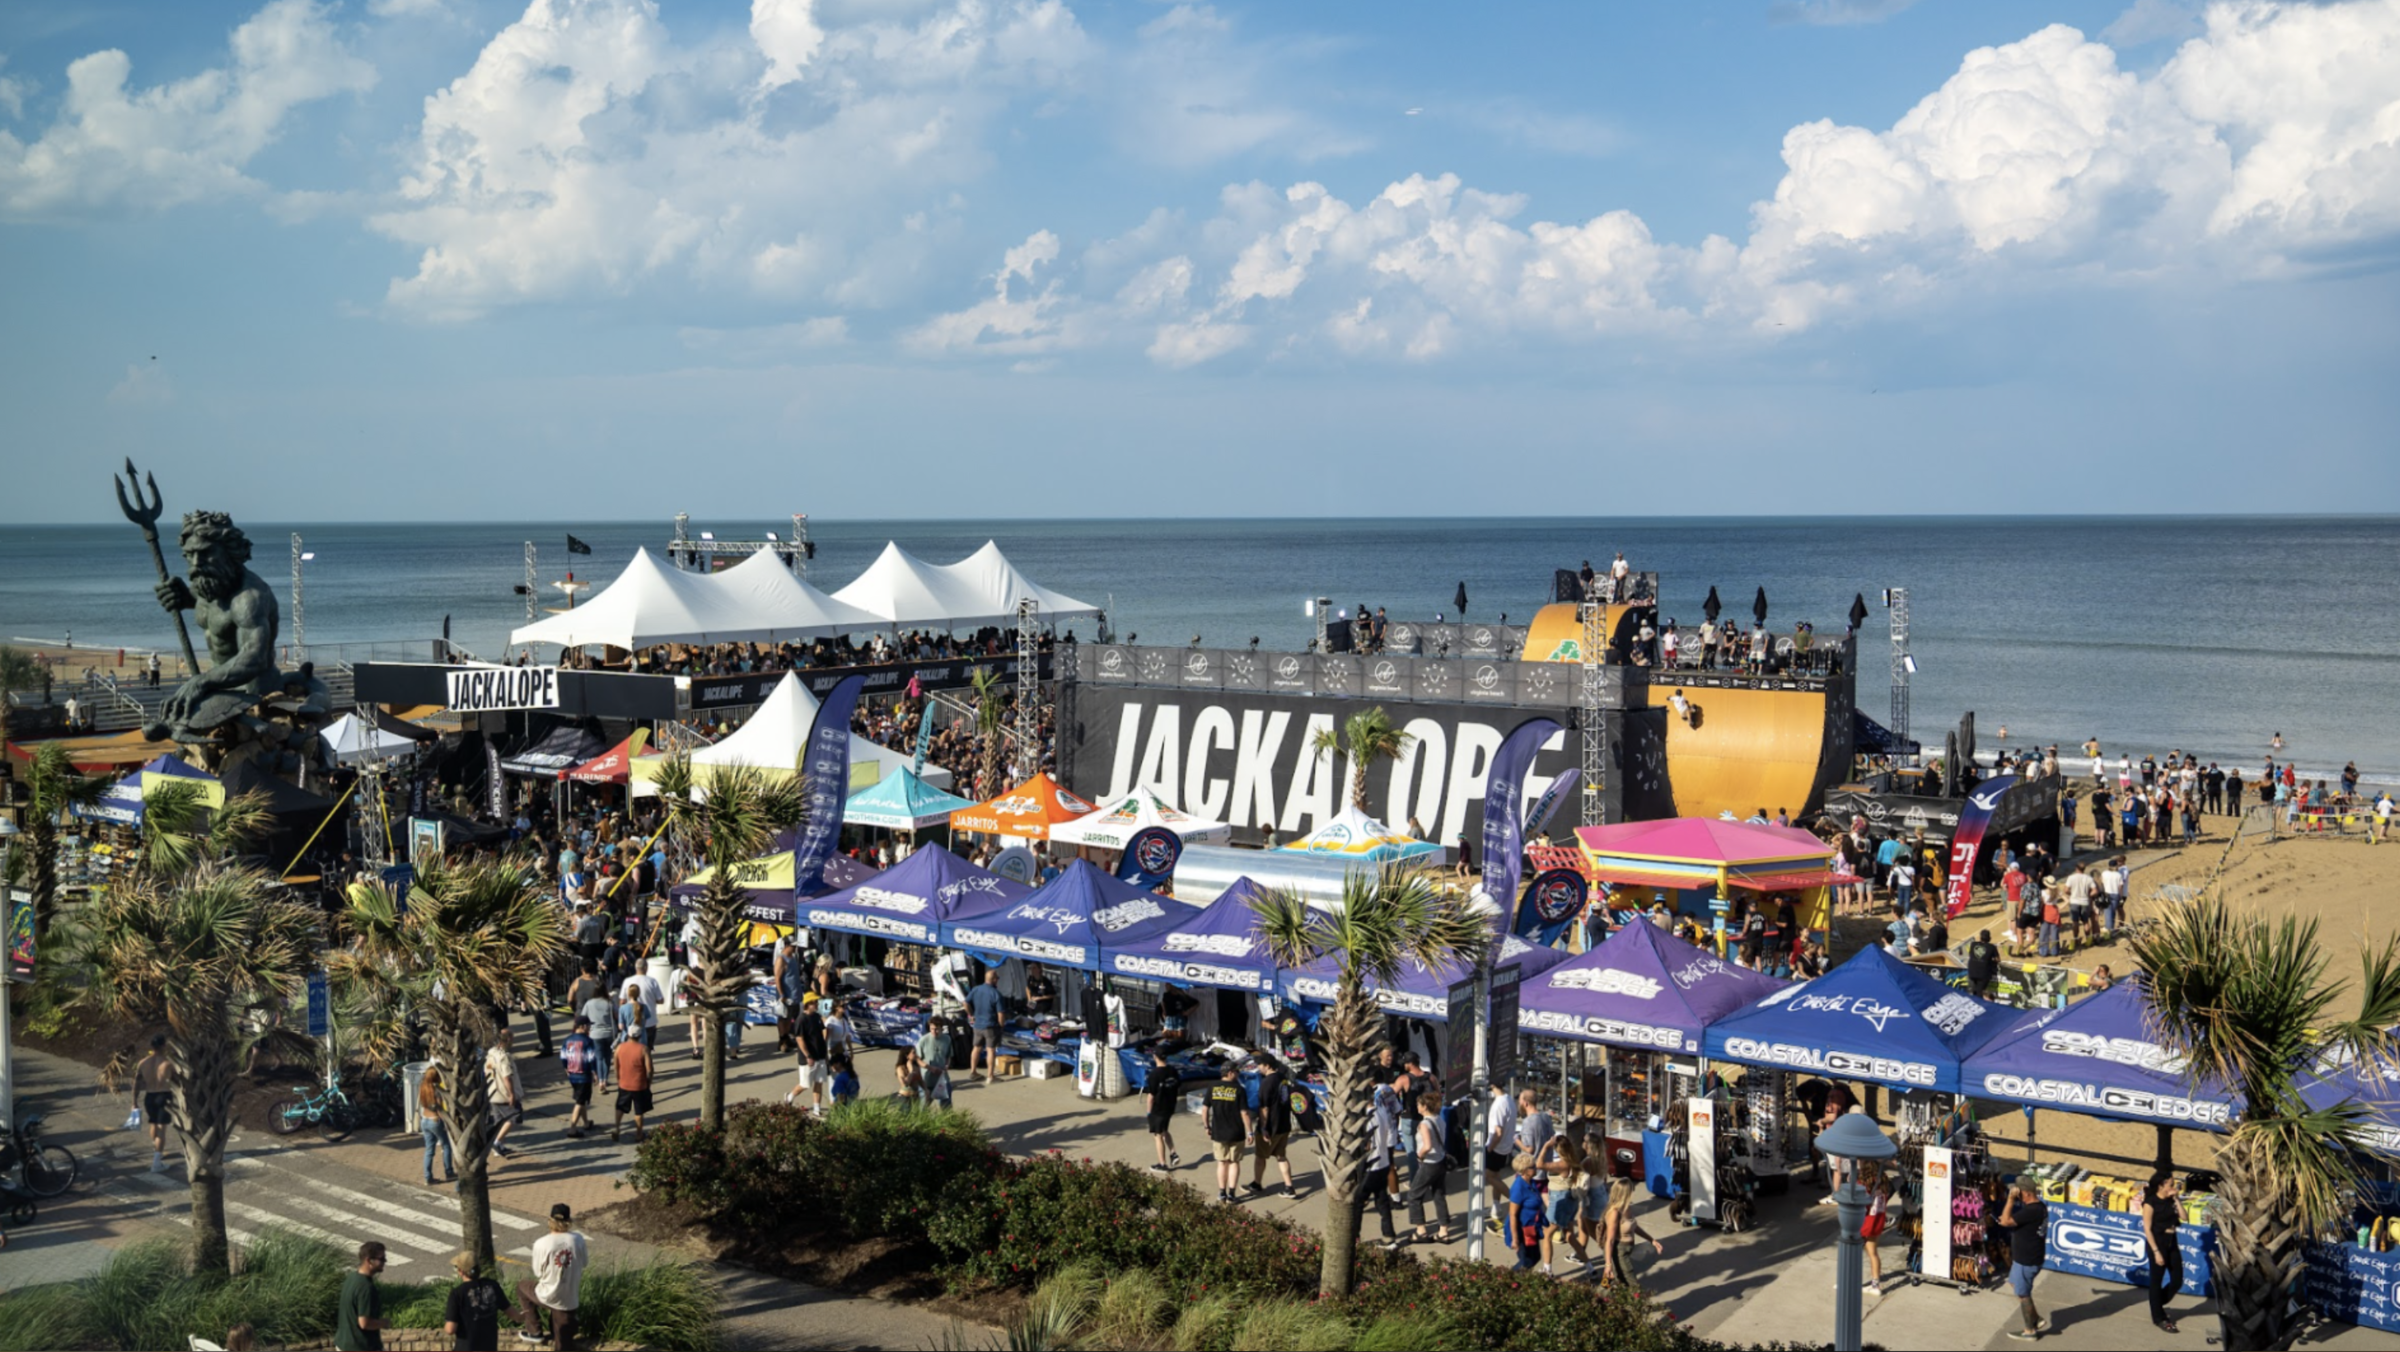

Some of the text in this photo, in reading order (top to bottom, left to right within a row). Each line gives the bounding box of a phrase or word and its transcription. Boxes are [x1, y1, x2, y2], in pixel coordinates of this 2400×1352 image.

[451, 668, 554, 710] JACKALOPE
[918, 667, 950, 681] ACKALOPE
[843, 813, 901, 825] ANOTHER.COM
[954, 816, 998, 831] JARRITOS
[1526, 790, 1558, 834] RUISER
[1082, 832, 1120, 846] JARRITOS
[809, 910, 867, 930] COASTAL
[891, 921, 927, 939] EDGE
[1093, 897, 1159, 923] COASTAL
[954, 928, 1018, 950] COASTAL
[1046, 943, 1086, 963] EDGE
[1115, 953, 1186, 978] COASTAL
[1216, 967, 1261, 988] EDGE
[1552, 967, 1665, 991] COASTAL
[1293, 976, 1340, 1000] COAS
[1409, 994, 1448, 1018] EDG
[1518, 1007, 1587, 1034] OASTAL
[1626, 1020, 1684, 1049] EDGE
[1851, 998, 1911, 1033] Edge
[1724, 1037, 1826, 1069] COASTAL
[1872, 1060, 1937, 1086] EDGE
[1984, 1073, 2103, 1105] COASTAL
[2154, 1095, 2231, 1124] EDGE
